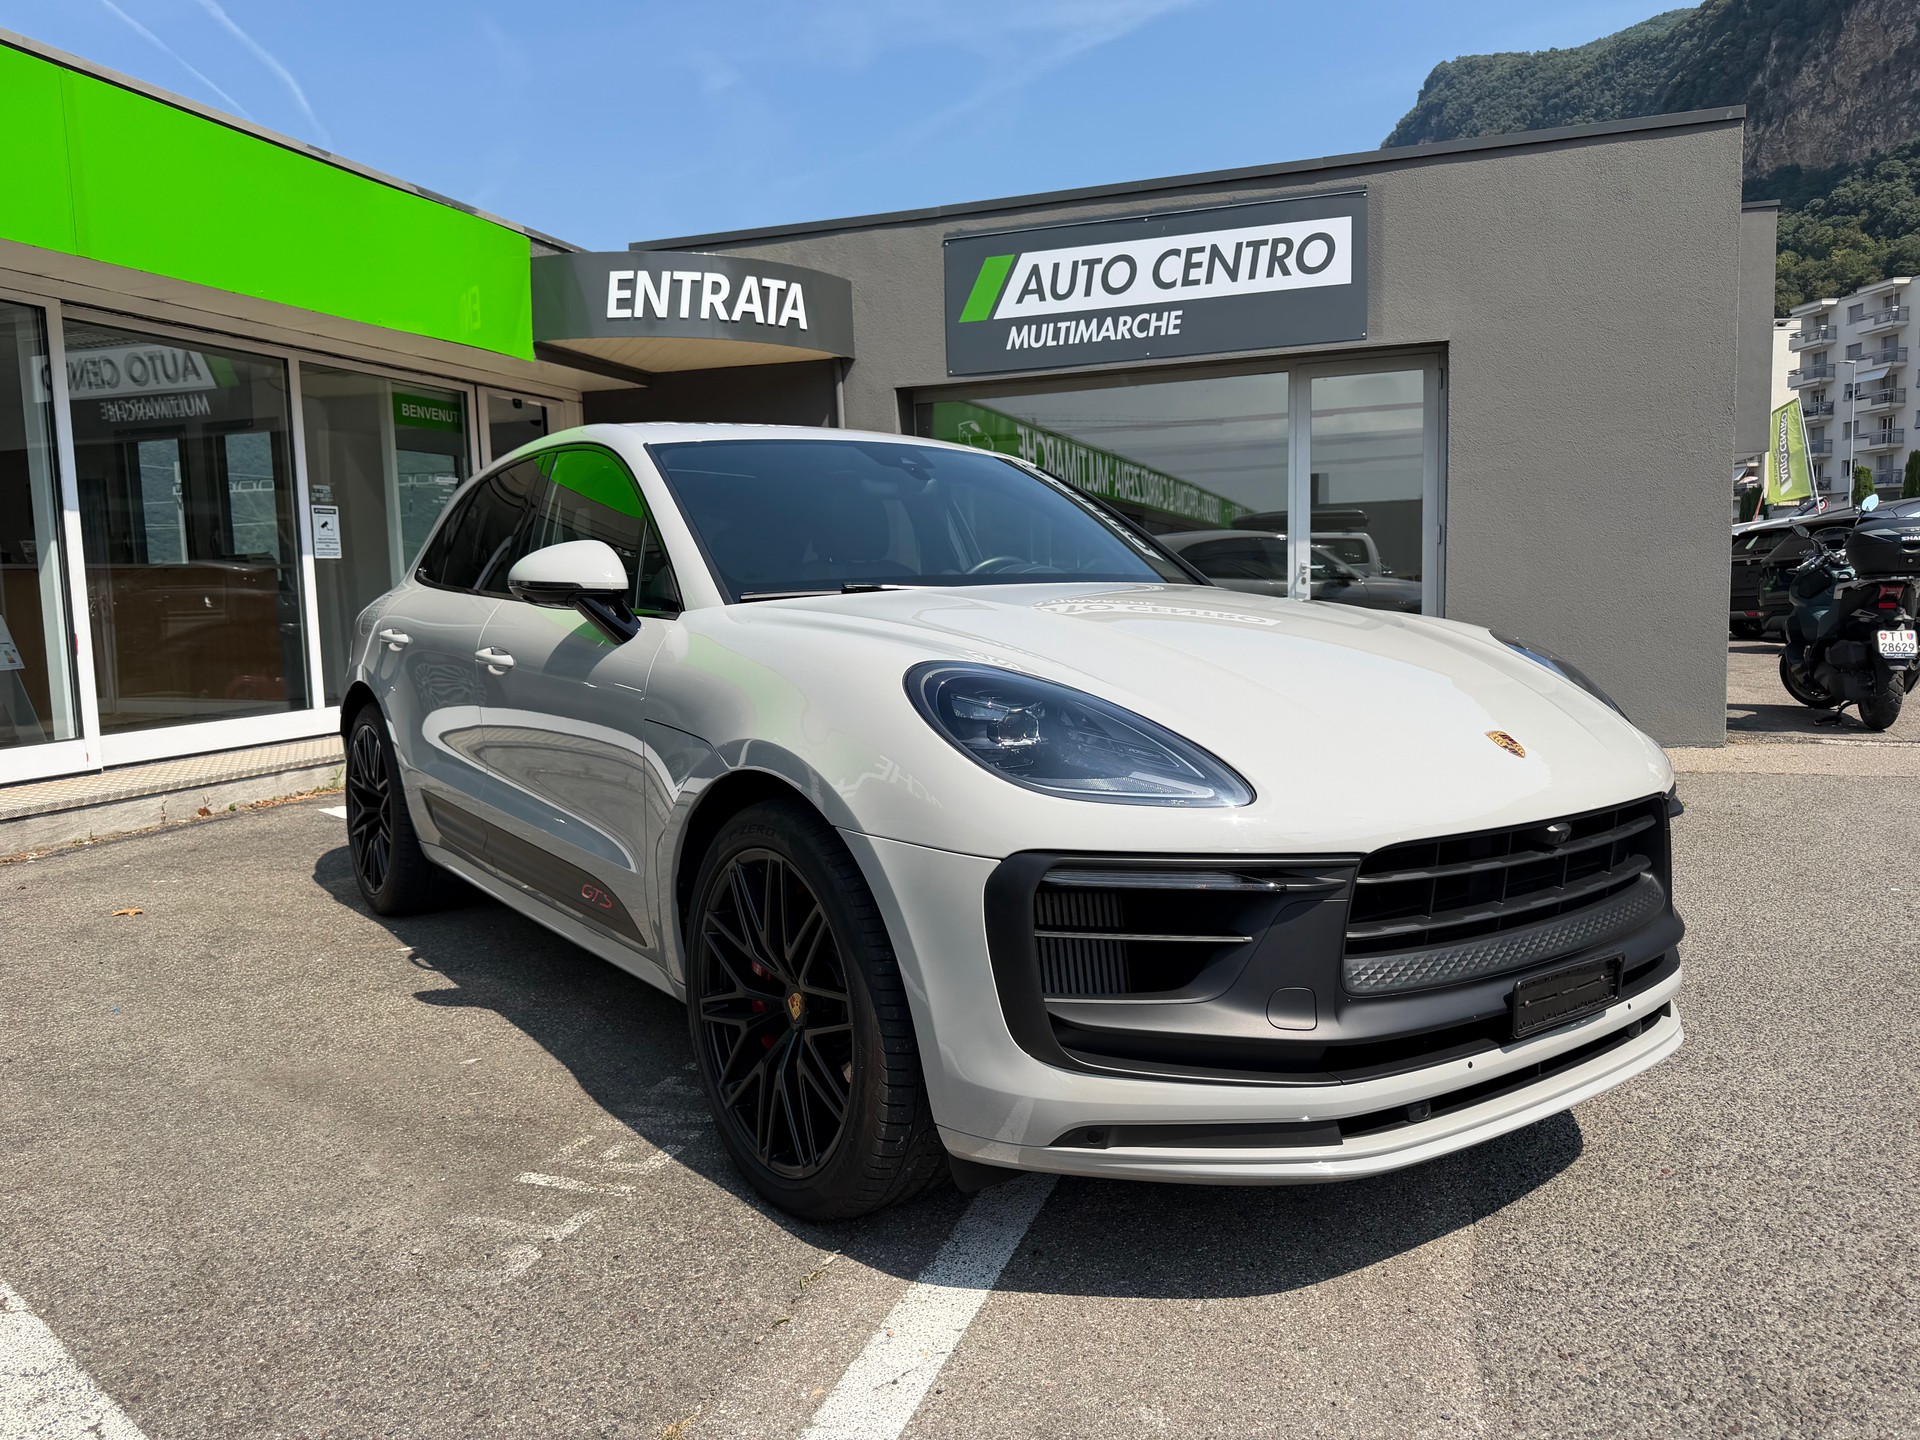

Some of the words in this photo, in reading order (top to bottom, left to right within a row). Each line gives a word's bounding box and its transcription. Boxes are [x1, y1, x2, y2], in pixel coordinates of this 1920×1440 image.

[1015, 254, 1138, 305] AUTO
[1152, 231, 1336, 290] CENTRO
[606, 270, 808, 330] ENTRATA
[1006, 310, 1183, 350] MULTIMARCHE
[1881, 642, 1915, 653] 28629
[581, 884, 613, 909] GTS
